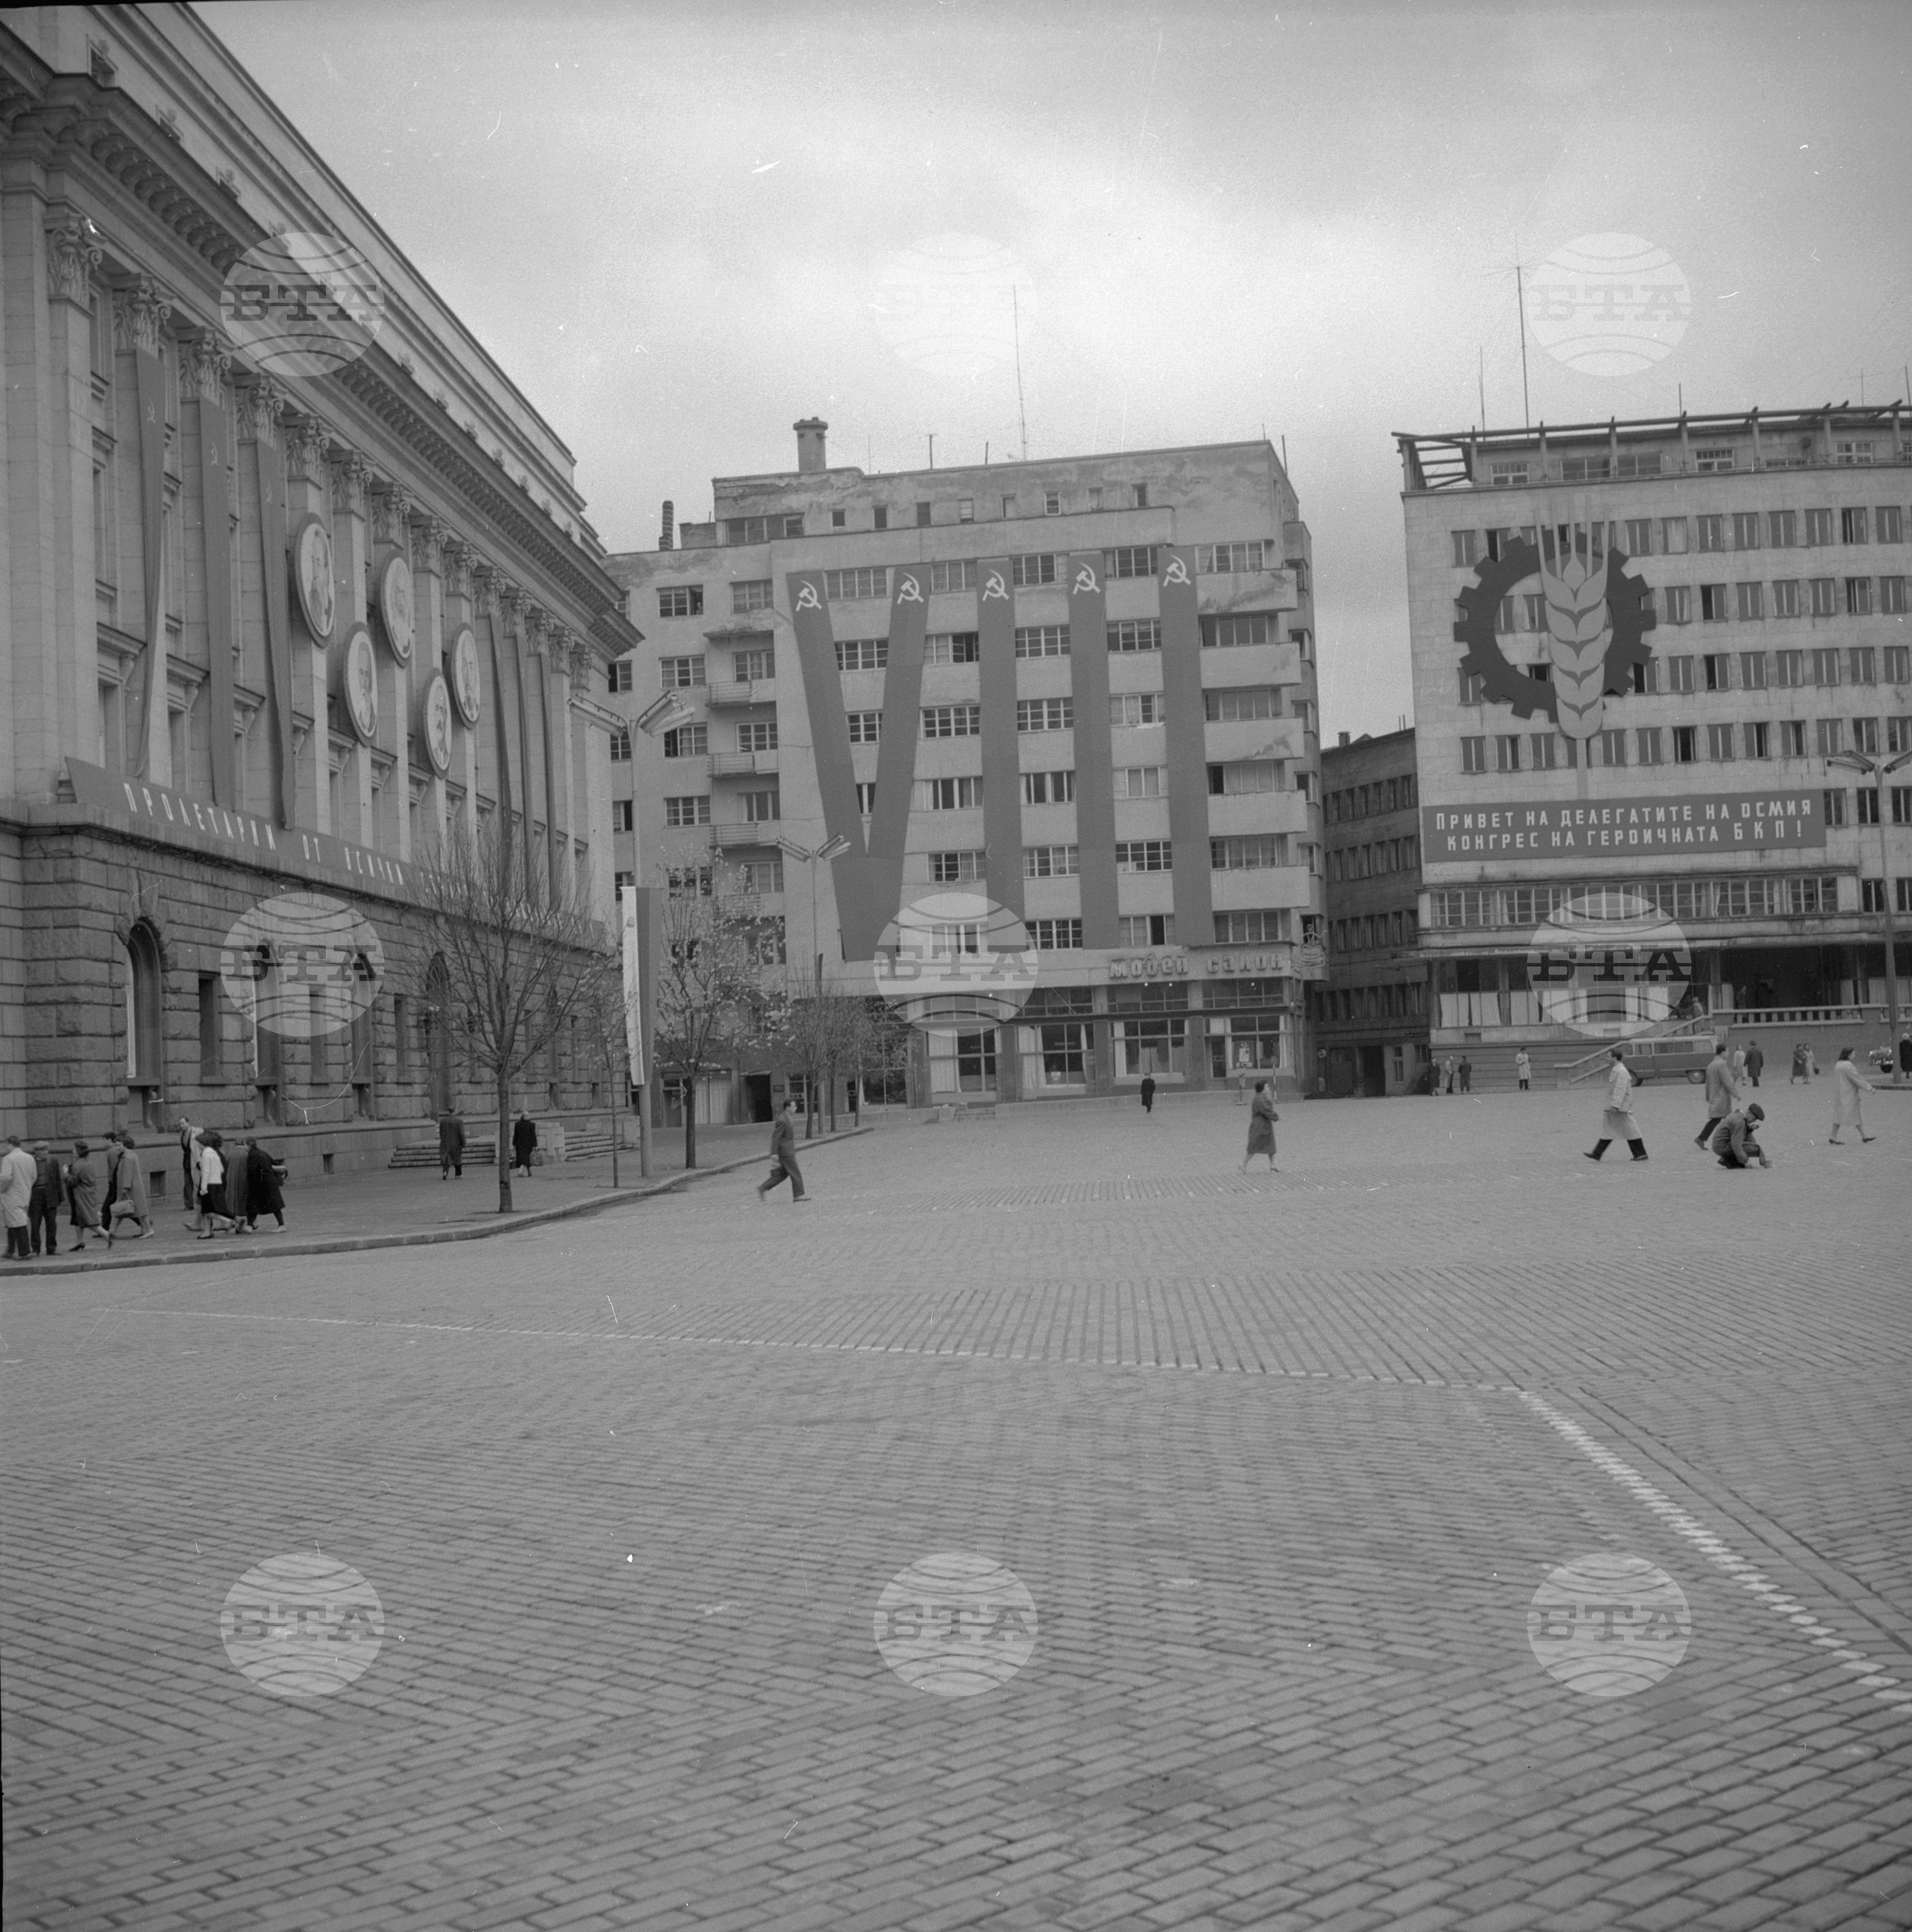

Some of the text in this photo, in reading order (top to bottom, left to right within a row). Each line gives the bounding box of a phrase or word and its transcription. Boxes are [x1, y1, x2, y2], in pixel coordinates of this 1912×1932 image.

[123, 782, 276, 850] ПРОЛЕТАРИИ
[302, 834, 321, 863] ОТ
[1436, 799, 1811, 830] ПРИВЕТ НА ДЕЛЕГАТИТЕ НА ОСМИЯ
[1447, 832, 1538, 851] КОНГРЕС
[1552, 831, 1574, 846] НА
[1587, 825, 1718, 846] ГЕРОИЧНАТА
